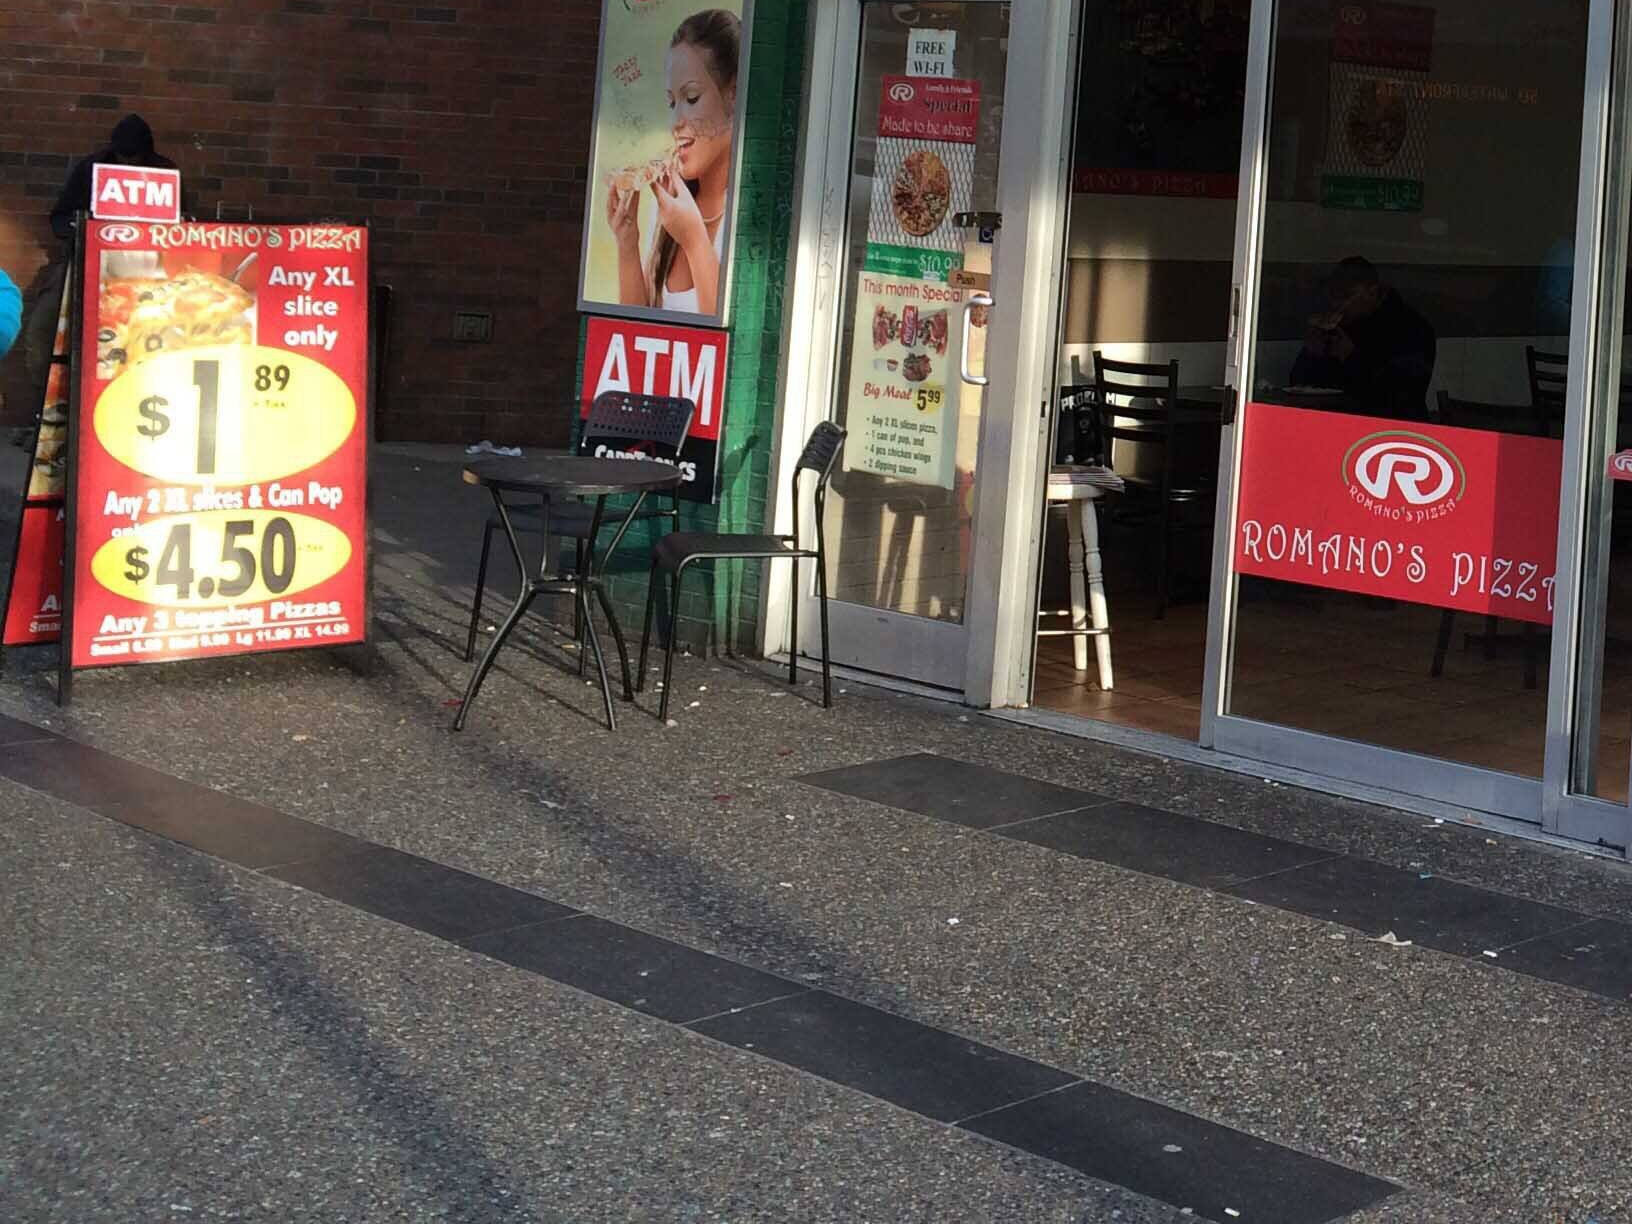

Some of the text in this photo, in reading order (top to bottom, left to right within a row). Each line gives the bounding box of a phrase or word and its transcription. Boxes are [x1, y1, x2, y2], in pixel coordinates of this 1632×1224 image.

[915, 41, 946, 55] FREE
[914, 61, 945, 75] WI-FI
[882, 116, 909, 133] Made
[943, 121, 973, 137] share
[100, 178, 174, 208] ATM
[149, 224, 283, 250] ROMANO'S
[288, 228, 361, 252] PIZZA
[269, 266, 354, 292] Any XL
[863, 279, 964, 303] This month Special
[284, 295, 338, 317] slice
[284, 324, 338, 351] only
[255, 364, 290, 392] 89
[594, 333, 717, 426] ATM
[864, 382, 880, 399] Big
[104, 490, 143, 521] Any
[268, 484, 303, 507] Can
[308, 481, 343, 508] Pop
[1349, 485, 1456, 523] ROMANO'S PIZZA
[124, 517, 296, 600] $4.50
[1242, 520, 1426, 584] ROMANO'S
[100, 614, 148, 636] Any
[270, 601, 342, 620] Pizzas
